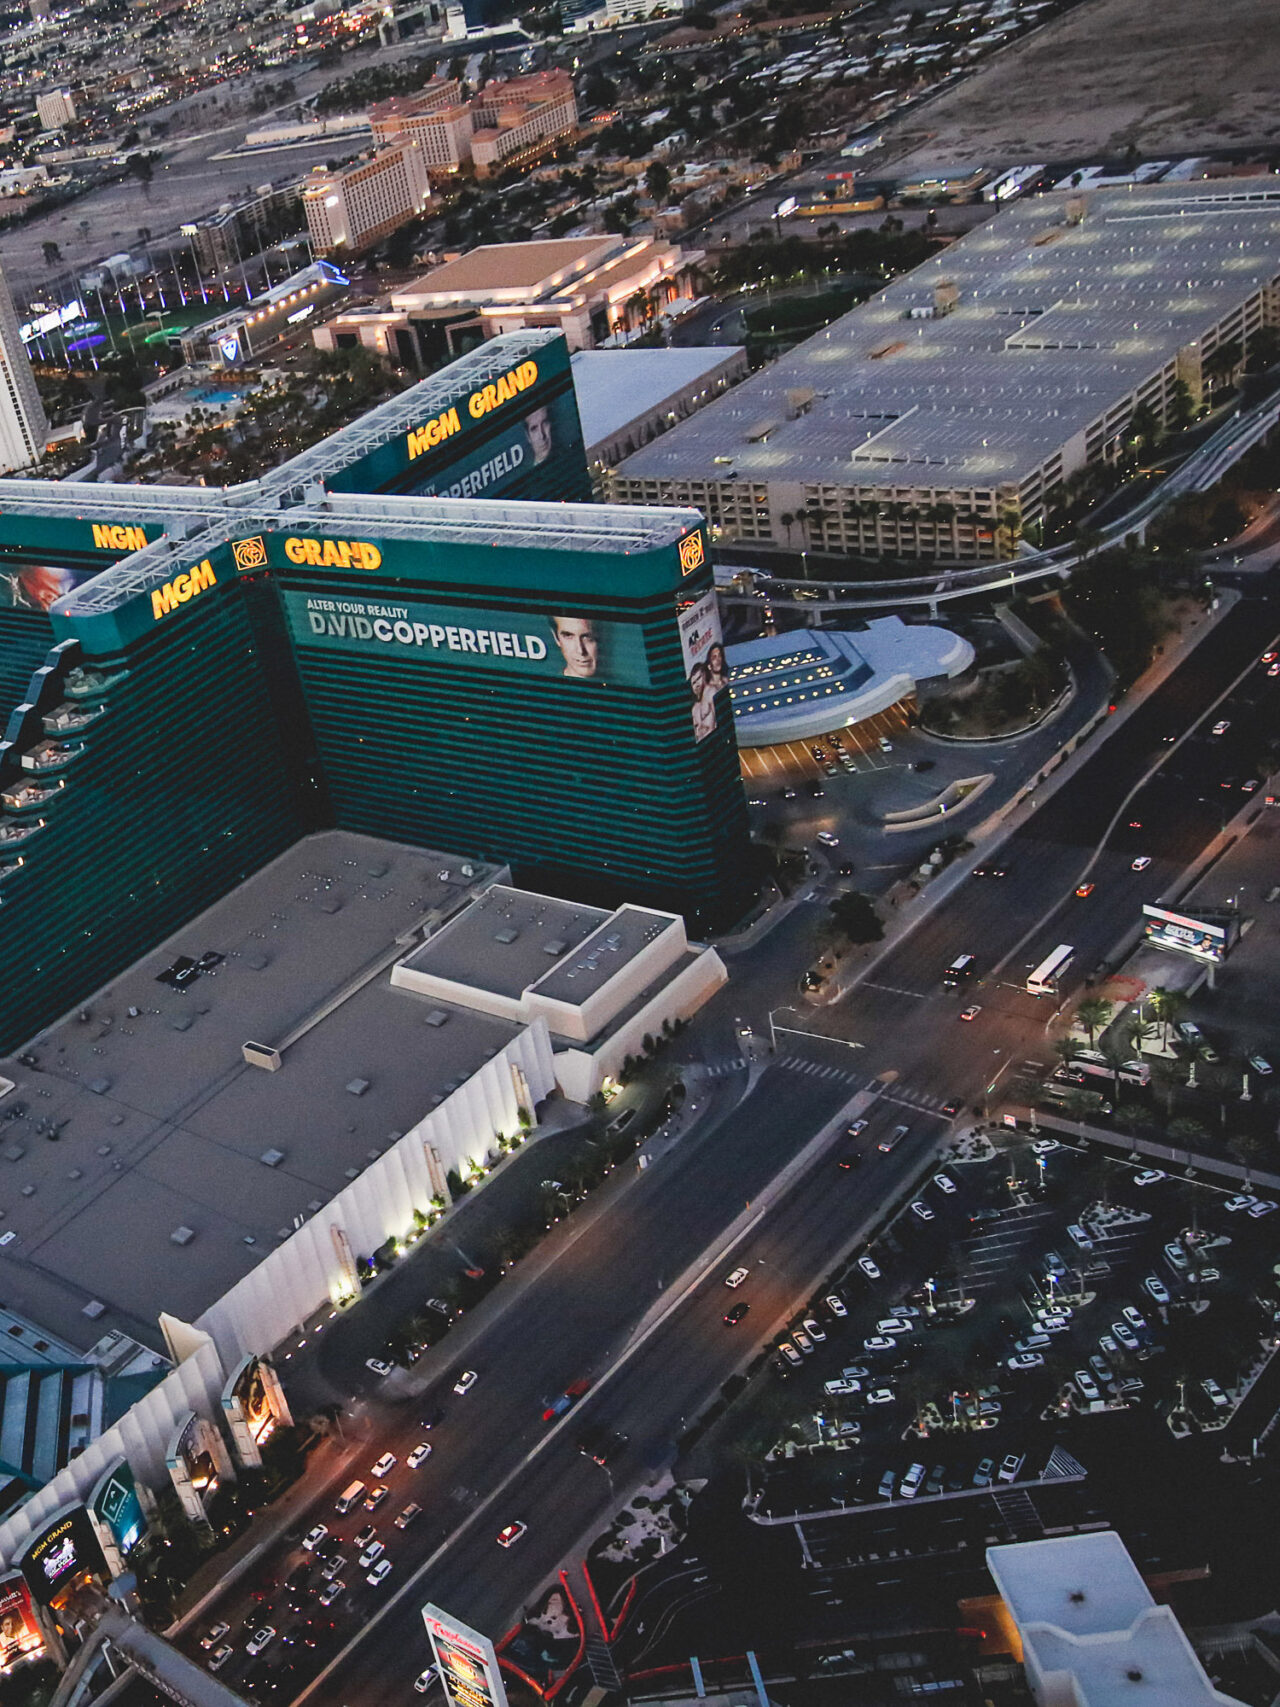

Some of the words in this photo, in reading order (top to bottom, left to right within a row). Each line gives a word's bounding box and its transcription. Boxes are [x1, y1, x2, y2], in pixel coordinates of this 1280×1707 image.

[407, 407, 461, 460] MGM
[468, 361, 538, 418] GRAND
[92, 524, 148, 551] MGM
[284, 537, 382, 571] GRAND
[151, 559, 217, 620] MGM
[307, 599, 335, 612] ALTER
[337, 602, 365, 615] YOUR
[367, 605, 408, 619] REALITY
[31, 1540, 48, 1561] MGM
[47, 1520, 73, 1543] GRAND
